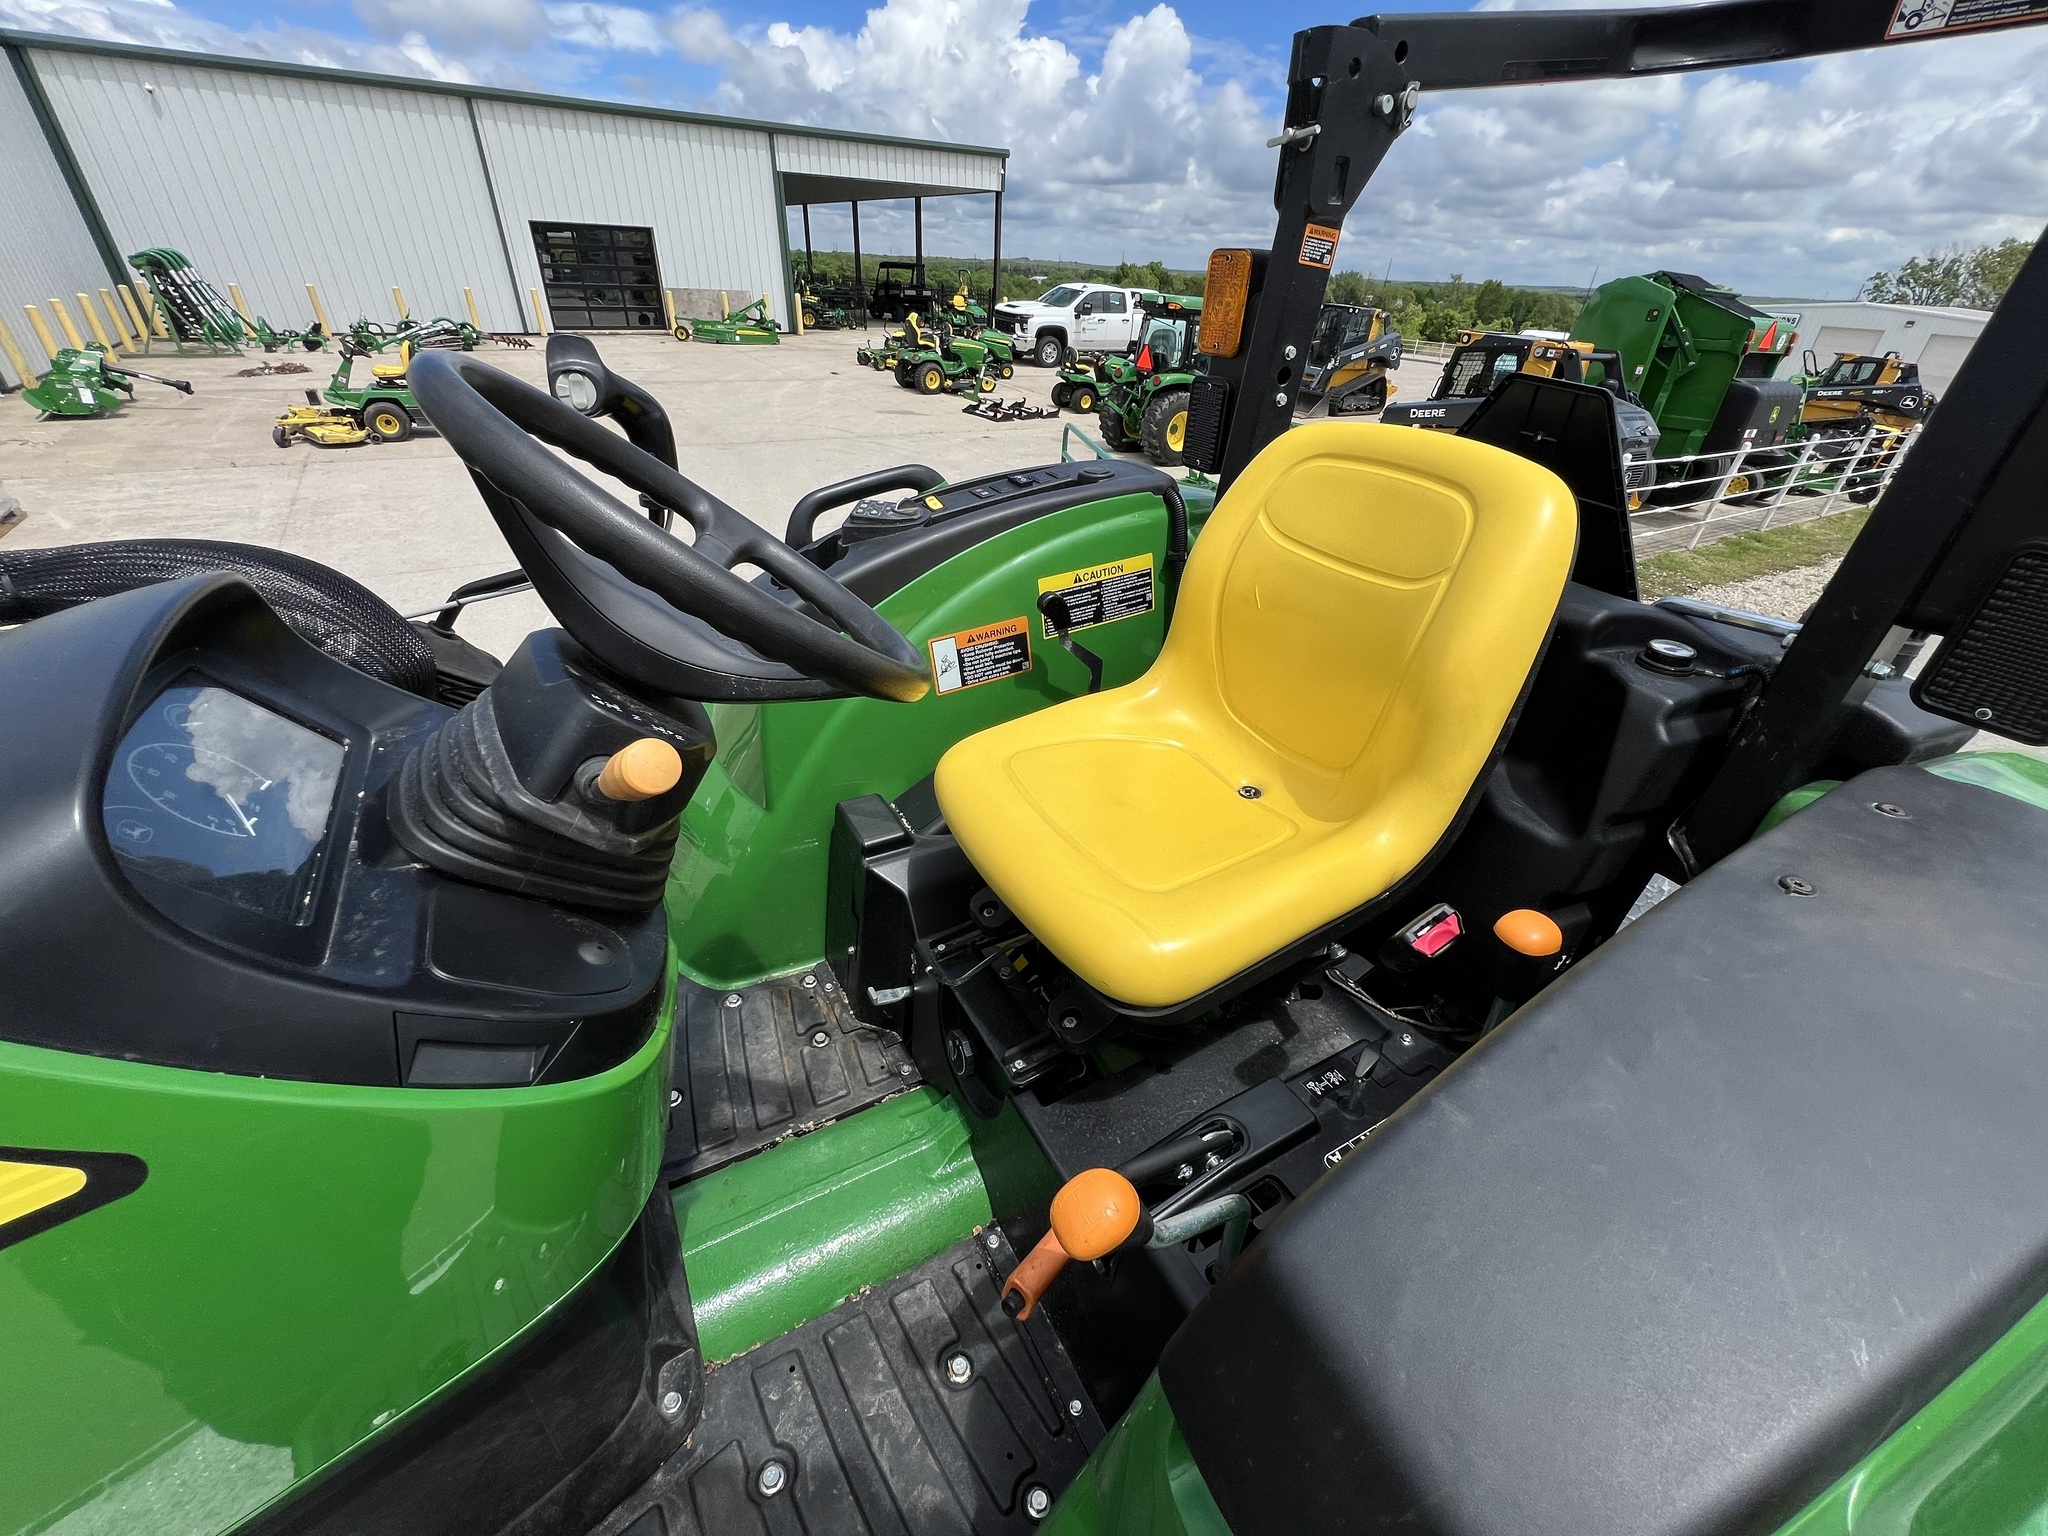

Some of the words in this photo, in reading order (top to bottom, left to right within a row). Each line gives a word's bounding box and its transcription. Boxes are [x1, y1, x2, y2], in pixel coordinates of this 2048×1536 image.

[1312, 230, 1336, 239] WARNING
[1410, 408, 1446, 418] DEERE
[1082, 564, 1124, 582] CAUTION
[975, 624, 1017, 641] WARNING
[993, 640, 1014, 649] Protective
[994, 650, 1012, 658] machine
